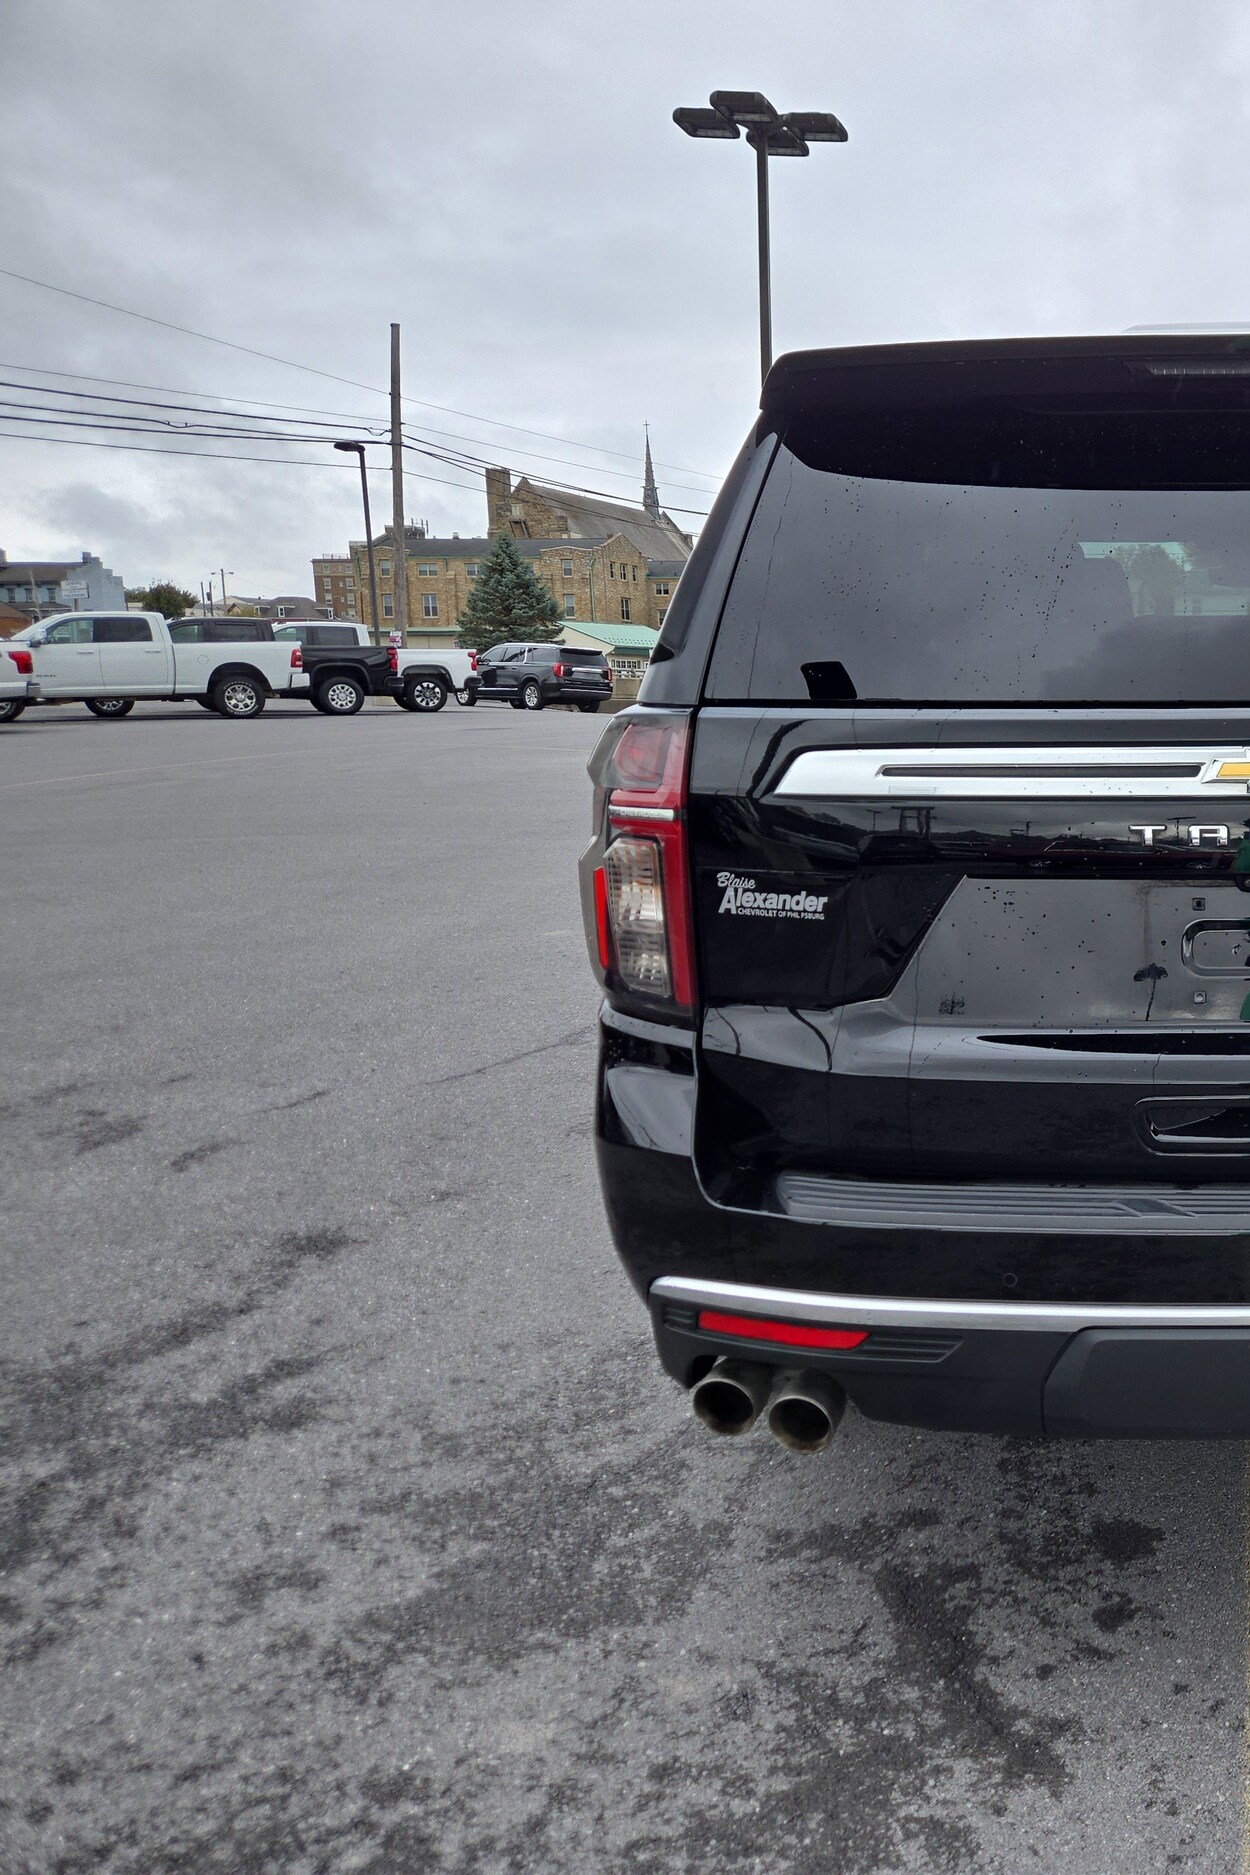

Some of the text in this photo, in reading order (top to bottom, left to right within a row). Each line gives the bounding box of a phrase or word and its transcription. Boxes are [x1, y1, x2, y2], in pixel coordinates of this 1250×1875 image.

[716, 871, 756, 889] Blaise
[718, 887, 828, 914] Alexander
[737, 907, 777, 917] CHEVROLET
[777, 910, 787, 918] OF
